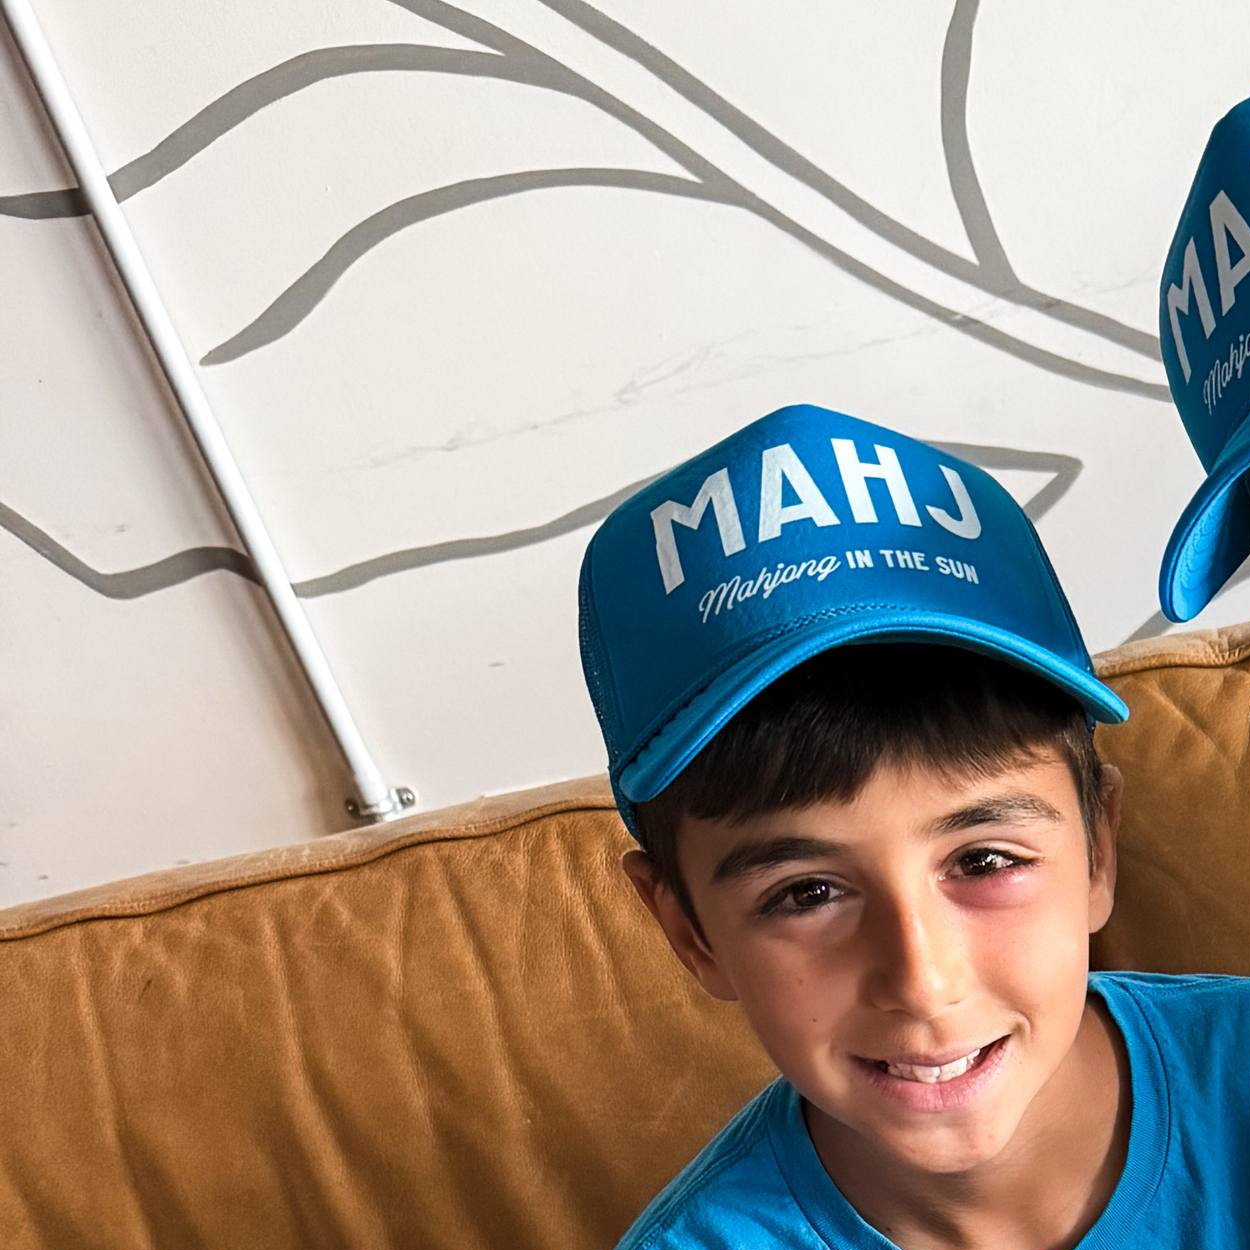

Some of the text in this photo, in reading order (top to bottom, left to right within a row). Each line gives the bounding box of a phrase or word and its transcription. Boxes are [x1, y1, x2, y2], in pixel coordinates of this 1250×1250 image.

[651, 439, 981, 594] MAHJ
[698, 549, 979, 623] Mahjong IN THE SUN
